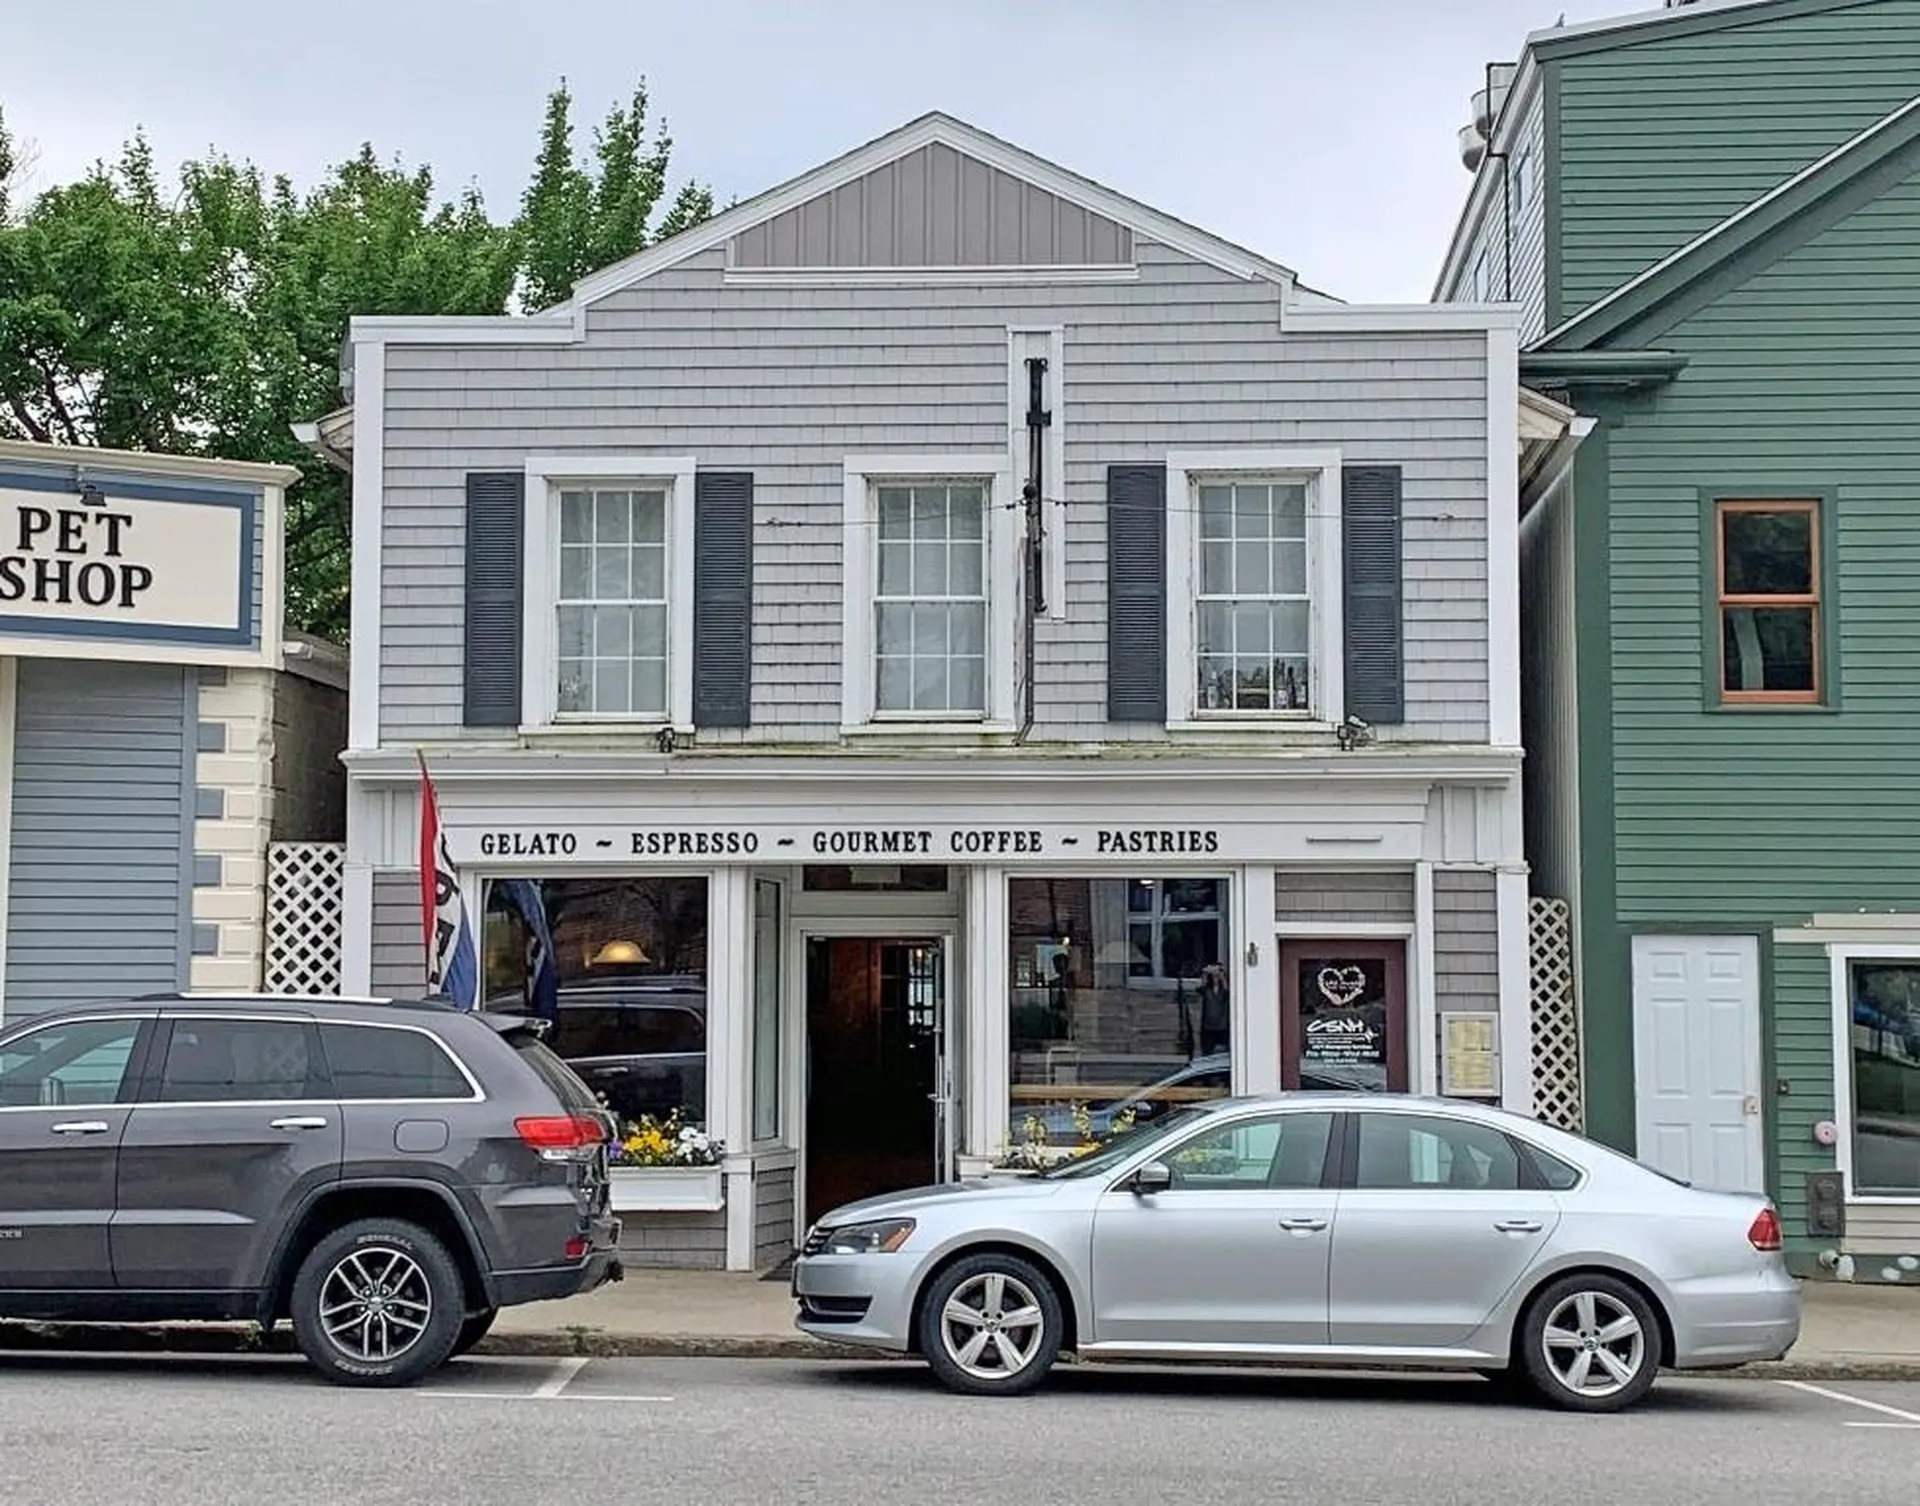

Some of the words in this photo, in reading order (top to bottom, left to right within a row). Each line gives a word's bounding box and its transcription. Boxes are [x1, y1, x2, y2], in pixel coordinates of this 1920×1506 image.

[17, 506, 132, 557] PET
[0, 556, 153, 608] SHOP
[480, 833, 577, 855] GELATO
[631, 831, 759, 854] ESPRESSO
[813, 830, 932, 853] GOURMET
[950, 830, 1043, 853] COFFEE
[1097, 830, 1218, 853] PASTRIES
